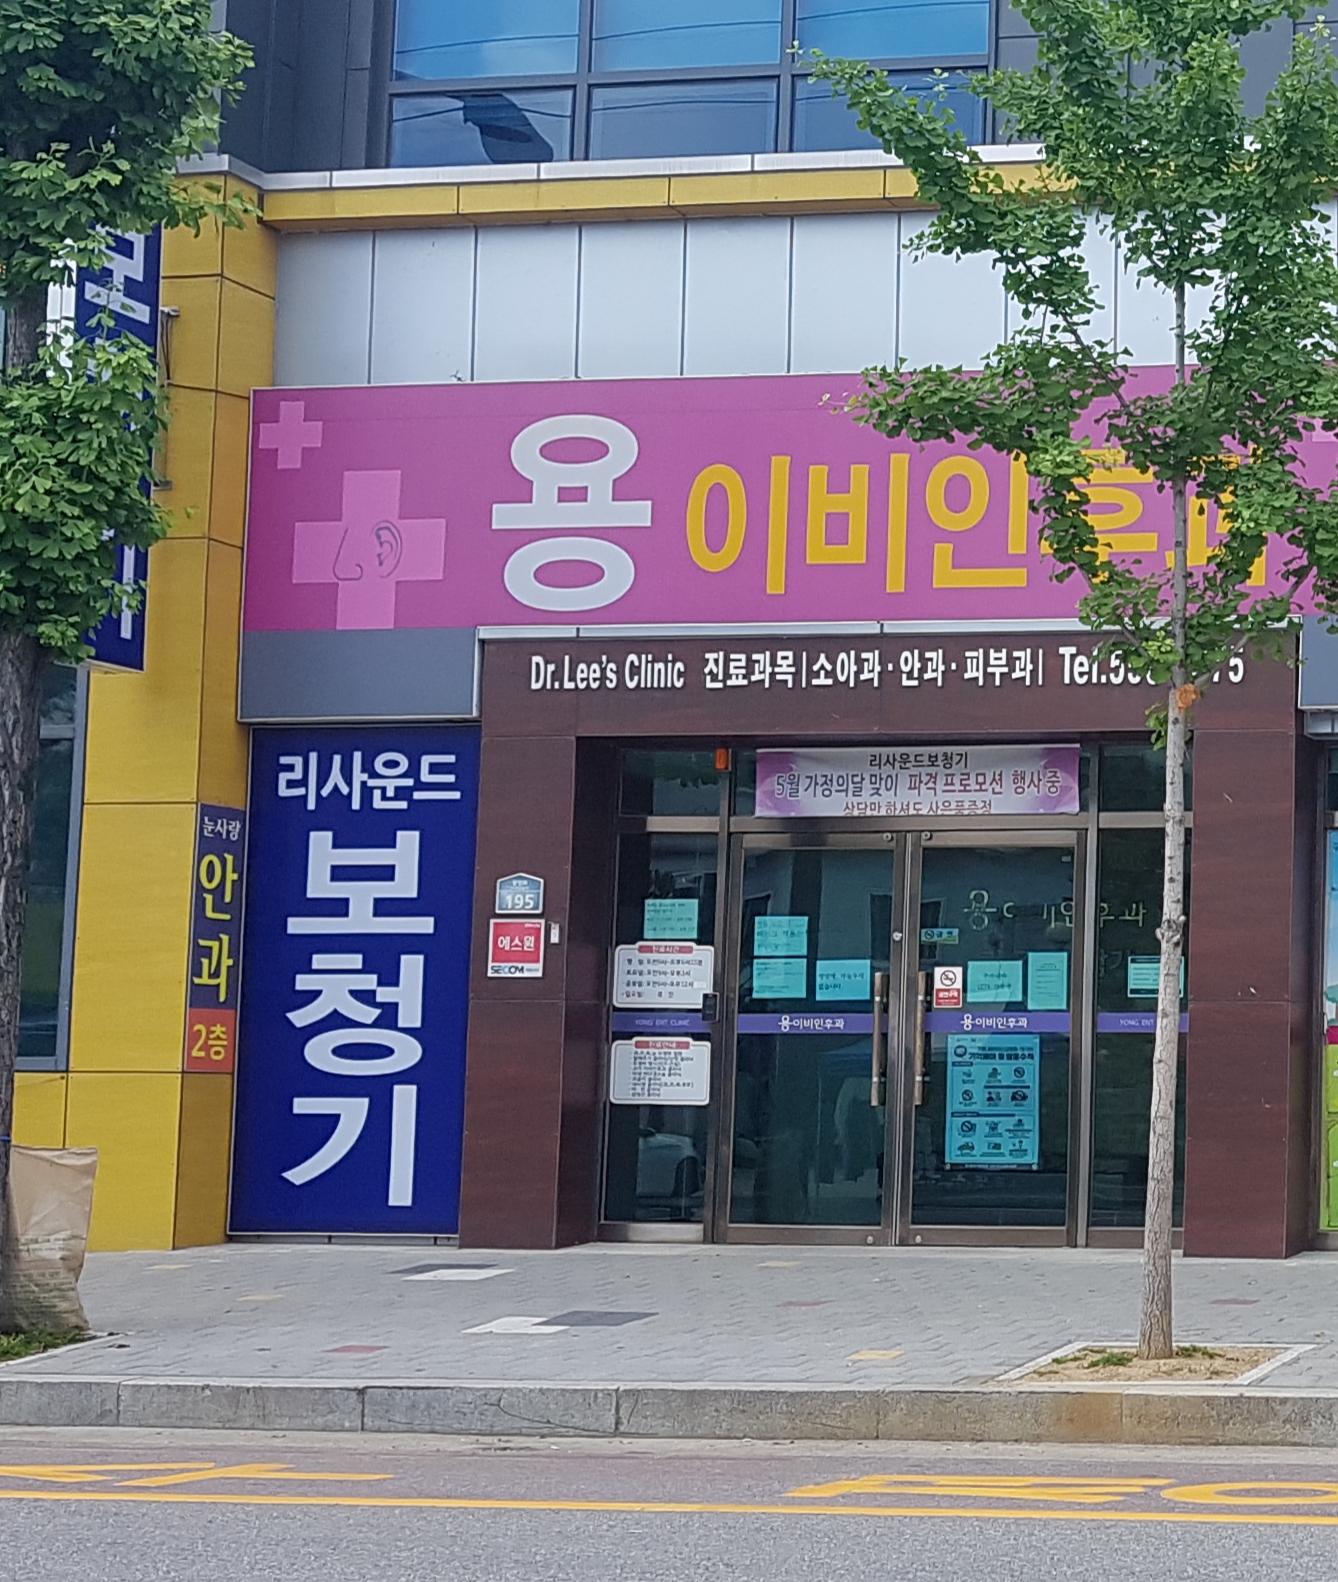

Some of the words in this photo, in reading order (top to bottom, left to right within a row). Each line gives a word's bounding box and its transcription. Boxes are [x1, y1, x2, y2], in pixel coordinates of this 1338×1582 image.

[624, 653, 686, 688] Clinic
[869, 752, 968, 770] 리사운드보청기
[277, 751, 462, 810] 리사운드
[775, 773, 800, 798] 5월
[907, 770, 937, 797] 파격
[941, 770, 1004, 796] 프로모션
[203, 816, 242, 842] 눈사랑
[505, 893, 535, 910] 195
[192, 852, 239, 1003] 안과
[497, 935, 535, 952] 에스원
[490, 965, 525, 975] SECOM
[281, 830, 435, 1207] 보청기
[777, 1014, 845, 1032] 용이비인후과
[960, 1013, 1028, 1031] 용이비인후과
[191, 1022, 229, 1061] 2층
